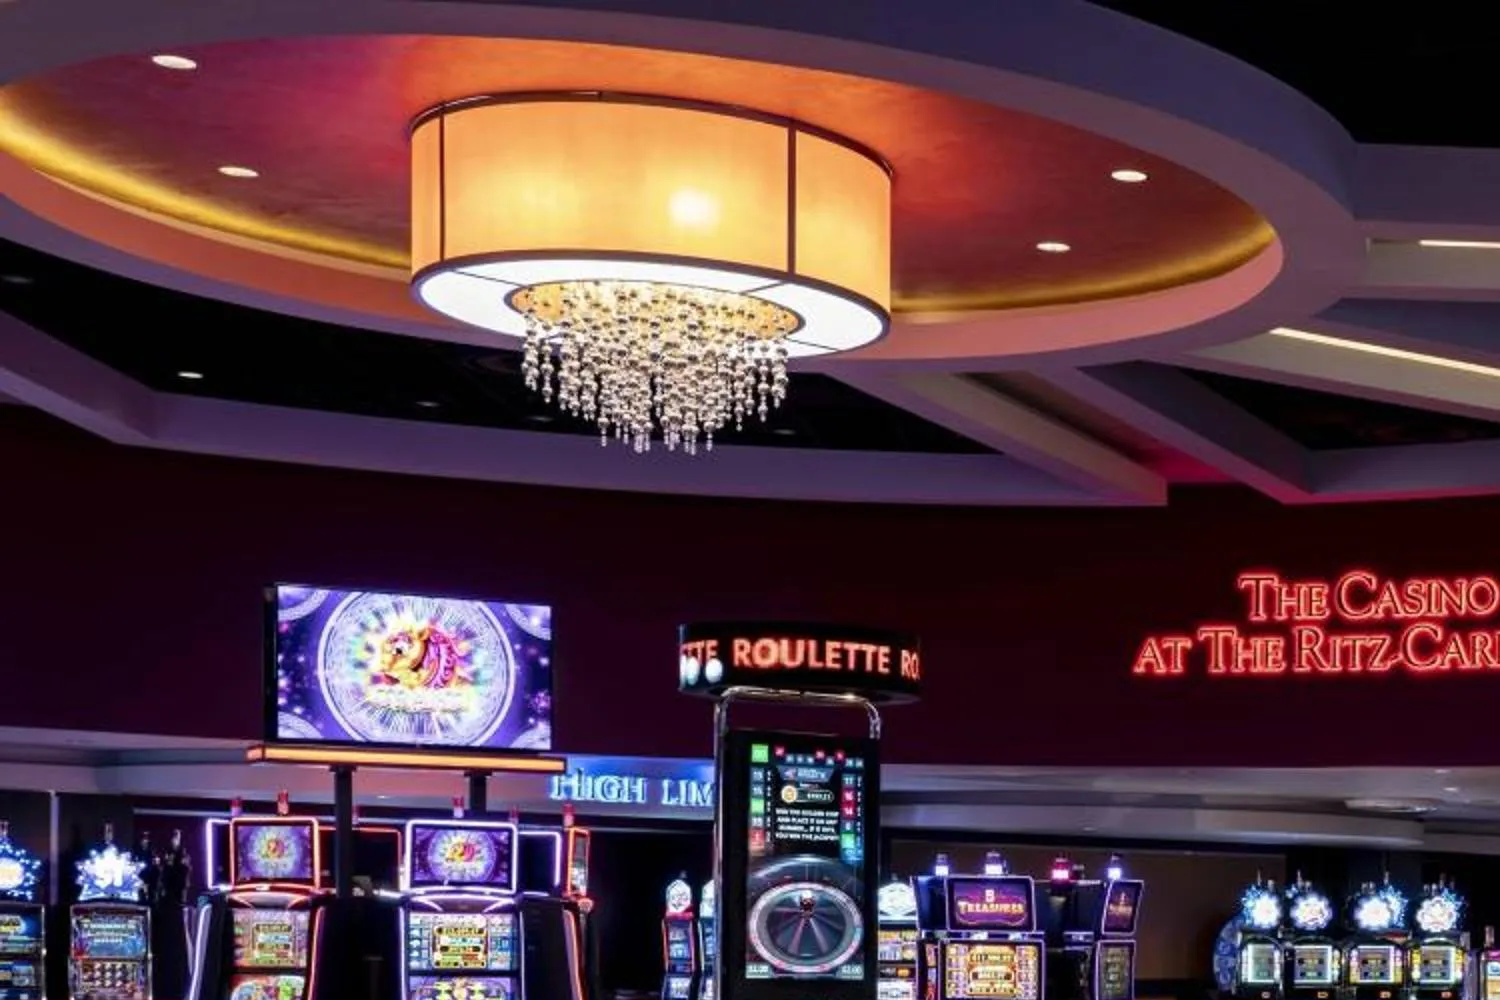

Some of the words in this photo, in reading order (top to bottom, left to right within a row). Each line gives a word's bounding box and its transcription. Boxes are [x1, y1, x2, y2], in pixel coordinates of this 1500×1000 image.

[1239, 573, 1330, 621] THE
[1335, 572, 1500, 620] CASINO
[733, 638, 891, 674] ROULETTE
[1134, 637, 1192, 674] AT
[1199, 626, 1286, 673] THE
[550, 774, 647, 803] HIGH
[958, 900, 1024, 914] TREASURES
